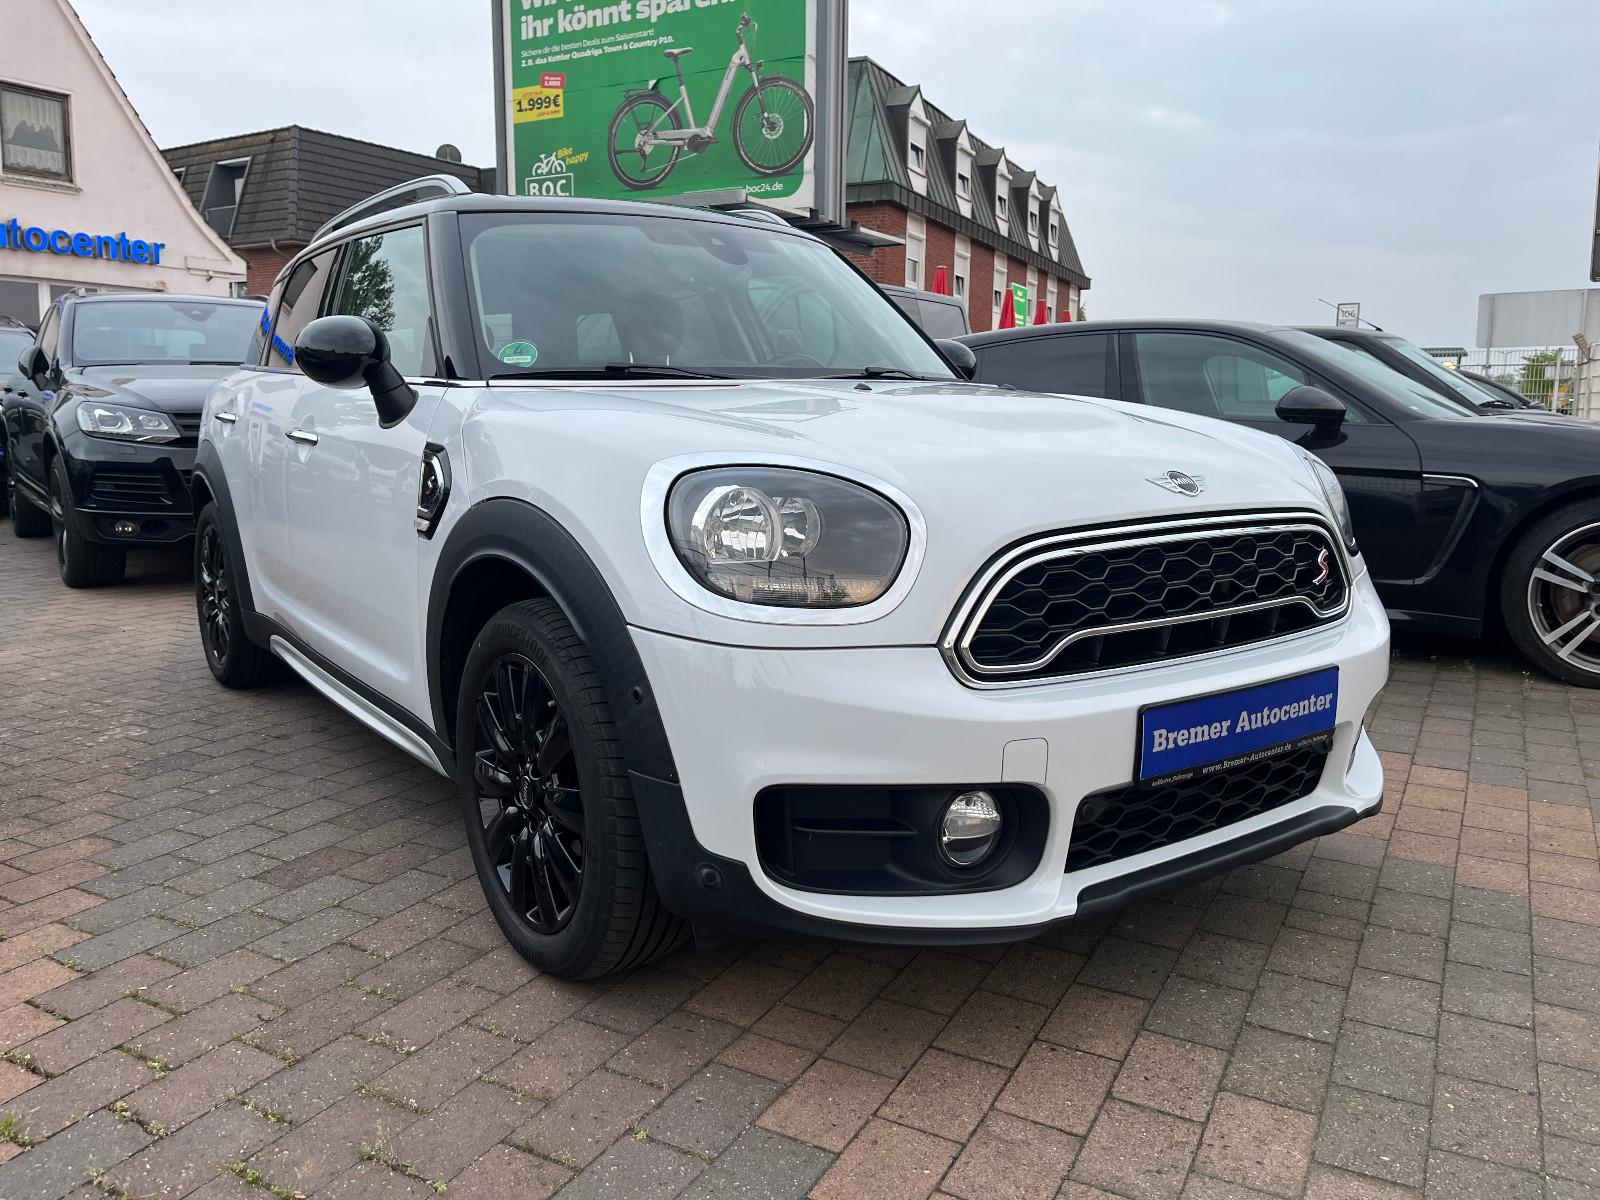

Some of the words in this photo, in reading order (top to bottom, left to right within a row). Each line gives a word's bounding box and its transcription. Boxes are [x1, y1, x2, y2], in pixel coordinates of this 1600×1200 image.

[521, 14, 554, 40] ihr
[557, 0, 632, 34] könnt
[636, 0, 735, 23] spar
[583, 37, 600, 47] Deals
[600, 35, 616, 44] zum
[629, 38, 658, 49] Country
[516, 94, 561, 113] 1.999€
[745, 181, 784, 194] boc24.de
[1152, 719, 1231, 752] Bremer
[1235, 692, 1333, 733] Autocenter
